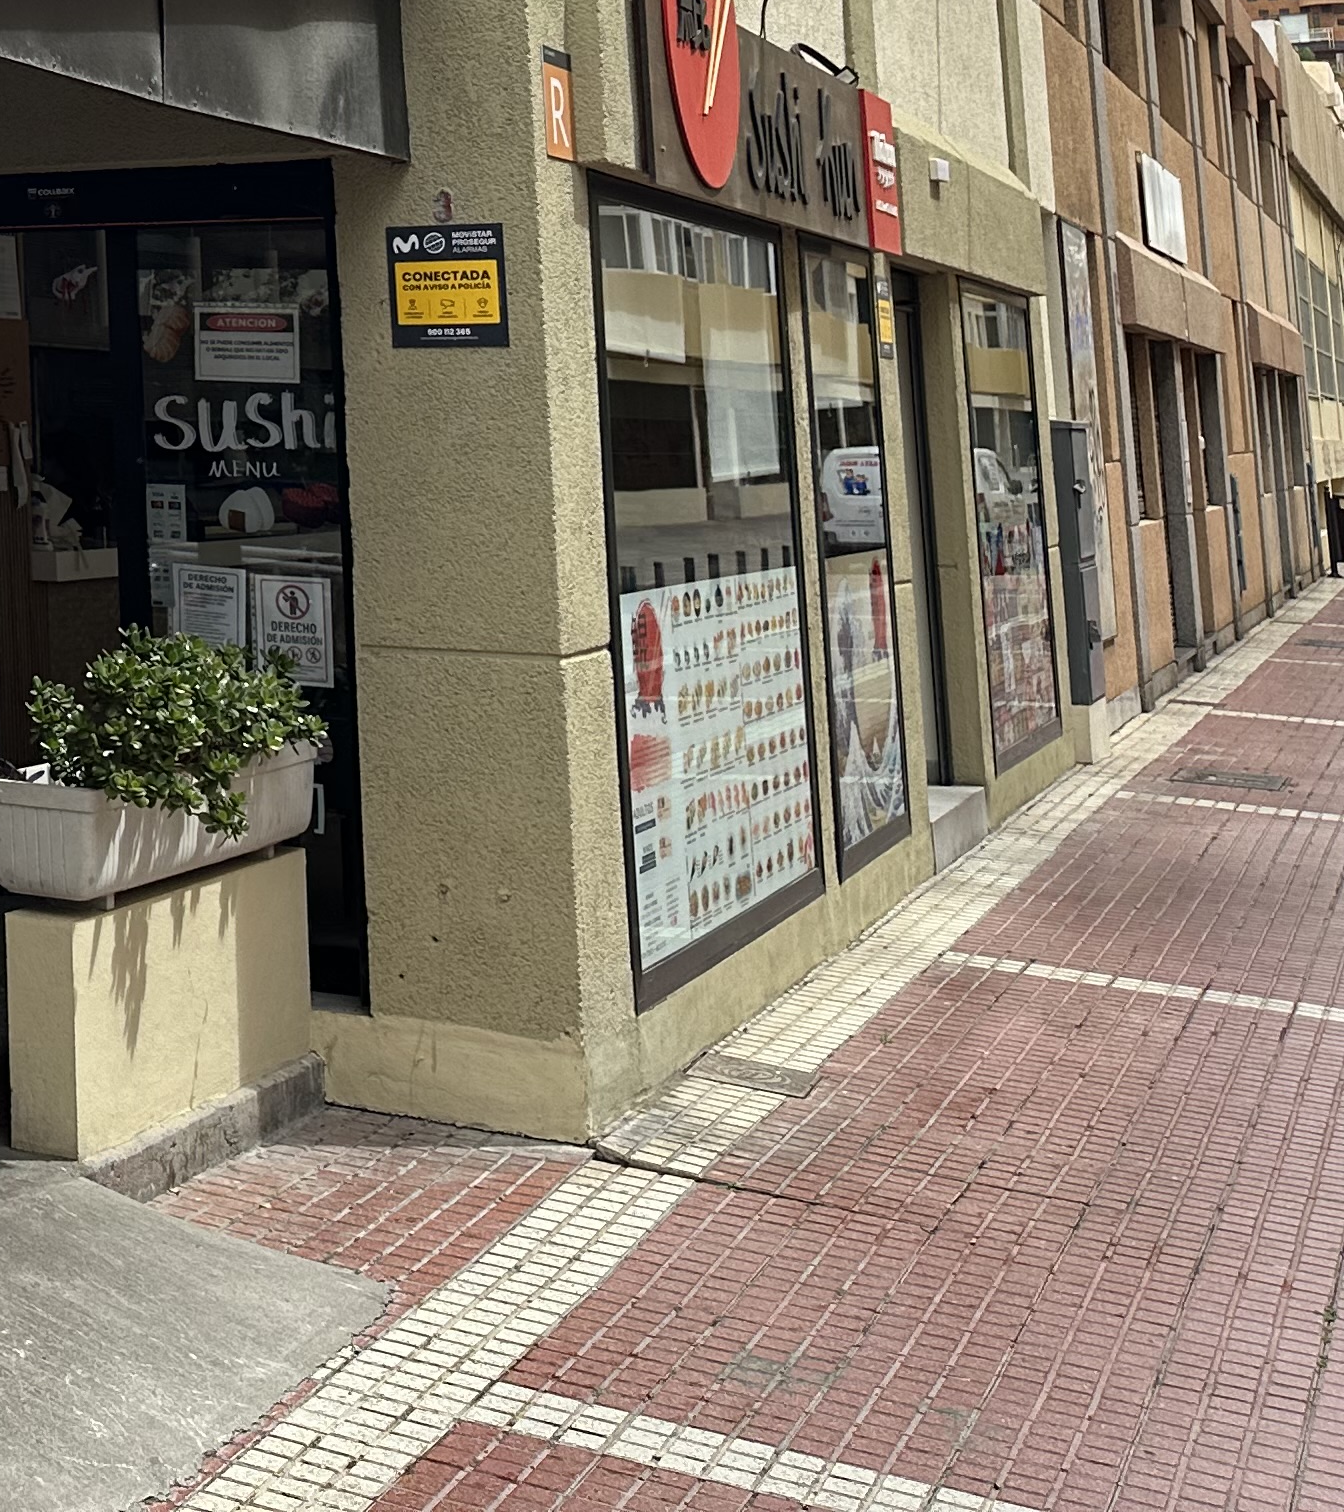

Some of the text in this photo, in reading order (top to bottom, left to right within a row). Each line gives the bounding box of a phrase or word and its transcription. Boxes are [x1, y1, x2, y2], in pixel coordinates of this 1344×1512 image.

[550, 76, 570, 148] R
[402, 270, 491, 282] CONECTADA
[217, 318, 276, 328] ATENCION
[209, 459, 281, 479] MENU
[187, 573, 227, 584] DERECHO
[183, 581, 194, 589] DE
[271, 620, 317, 634] DERECHO
[266, 634, 278, 643] DE
